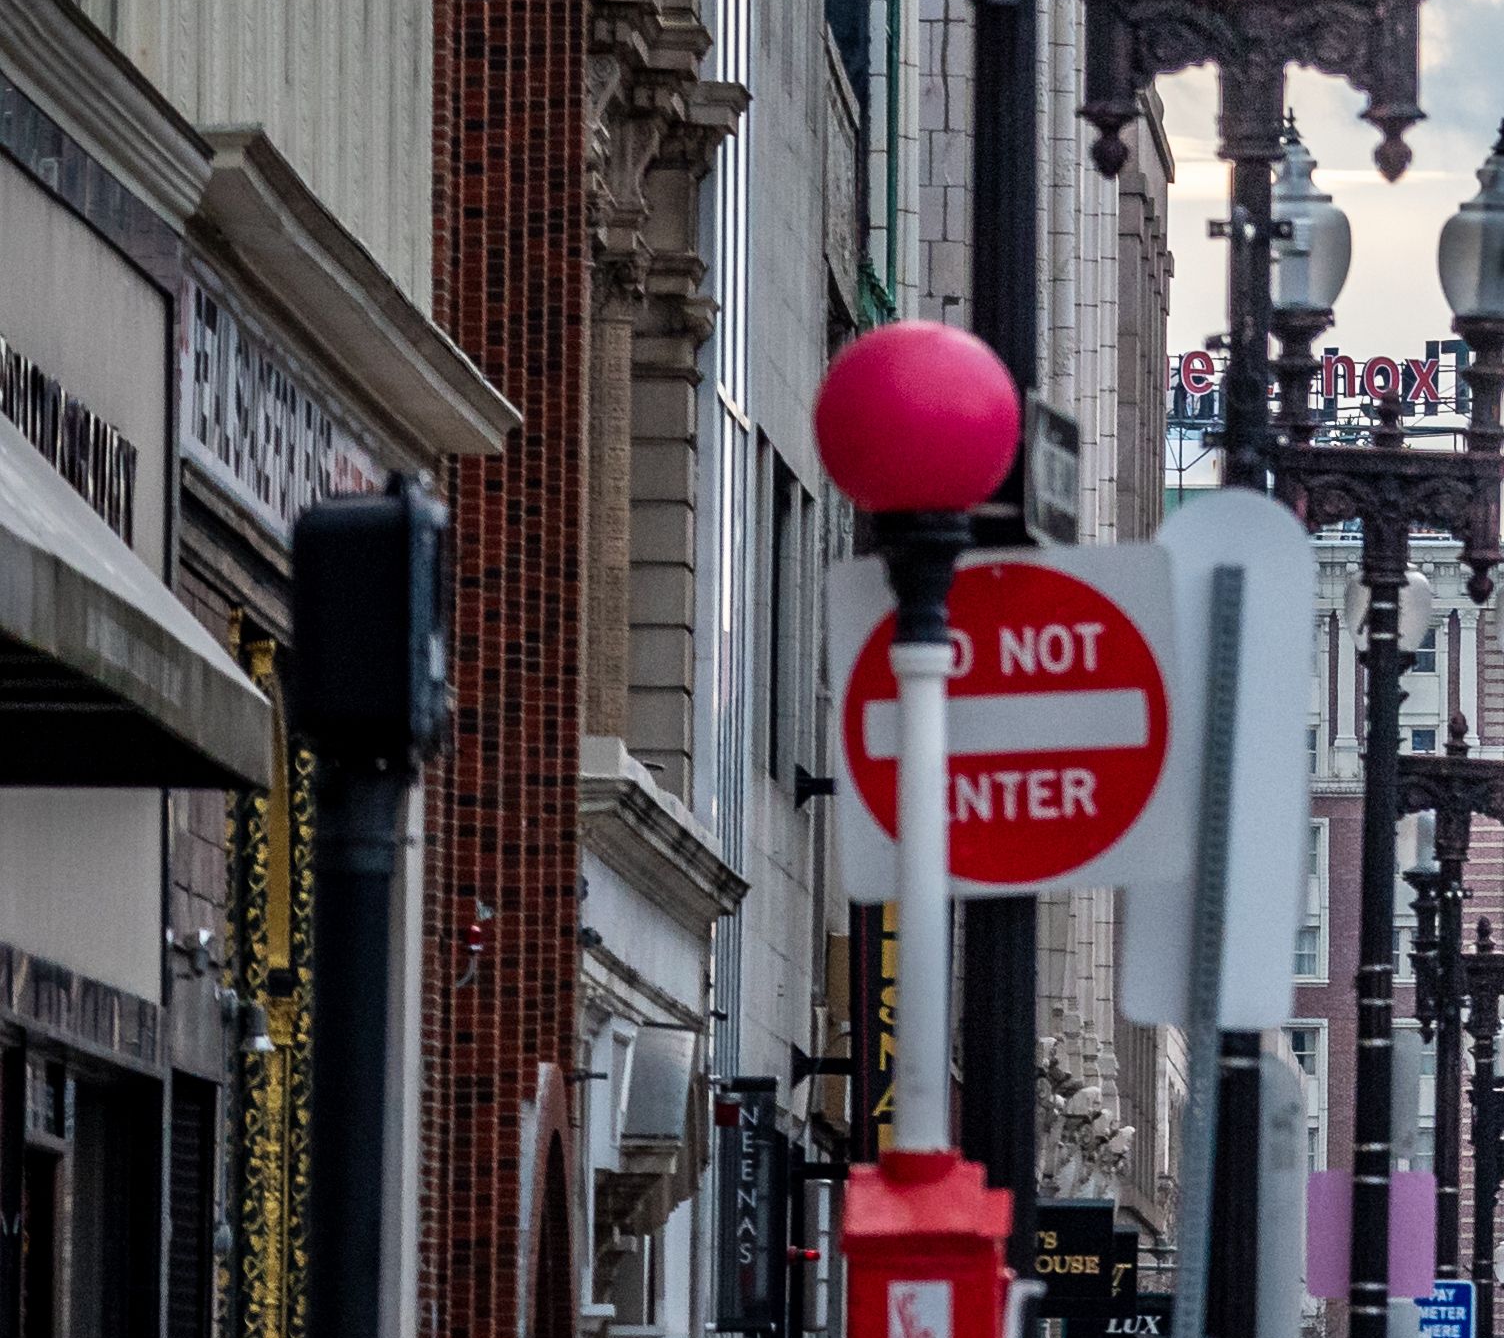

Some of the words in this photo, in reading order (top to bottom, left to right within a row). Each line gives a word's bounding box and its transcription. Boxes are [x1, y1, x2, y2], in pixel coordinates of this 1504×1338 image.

[1323, 354, 1441, 402] nox
[999, 623, 1105, 676] NOT
[951, 768, 1097, 823] NTER
[735, 1104, 760, 1265] NEENAS
[1034, 1256, 1100, 1274] OUSE
[1105, 1315, 1163, 1335] LUX
